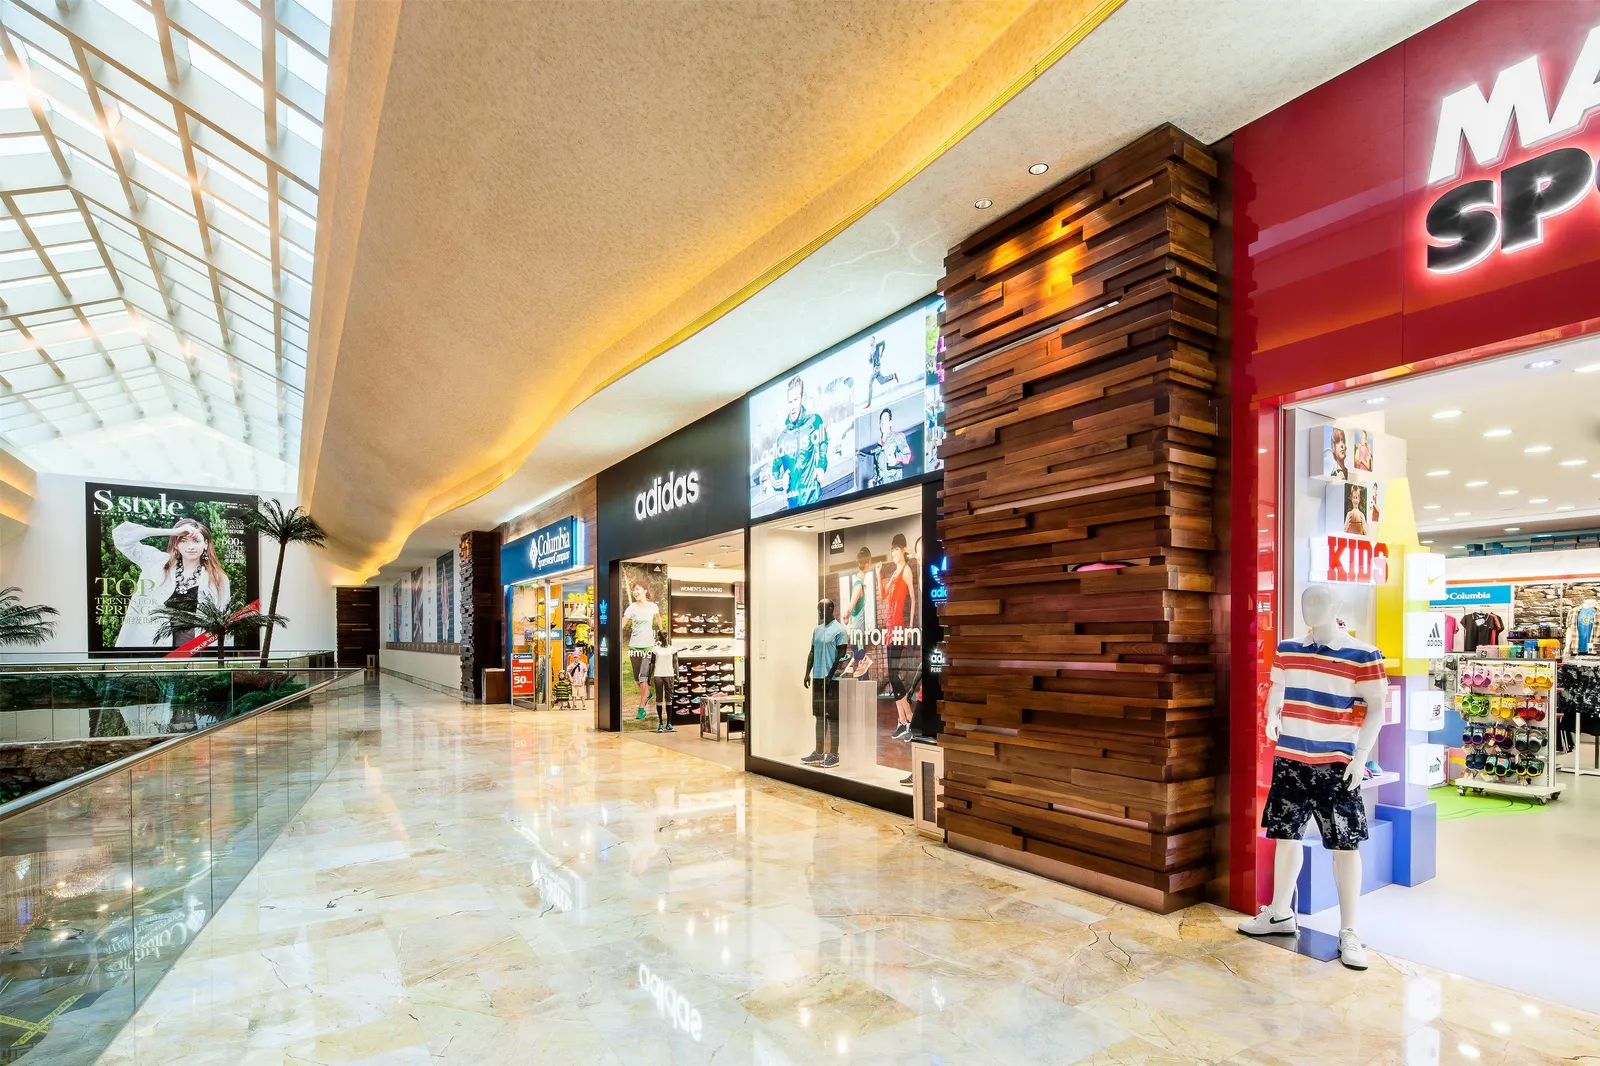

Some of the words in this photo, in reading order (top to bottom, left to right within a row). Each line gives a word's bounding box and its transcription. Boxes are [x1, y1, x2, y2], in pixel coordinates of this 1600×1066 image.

[1426, 147, 1600, 274] SP
[118, 493, 184, 516] style
[635, 471, 699, 521] adidas
[538, 527, 570, 557] Columbia
[1327, 536, 1389, 585] KIDS
[95, 577, 156, 597] TOP
[1449, 592, 1490, 600] Columbia
[95, 597, 136, 605] TRENDS
[95, 605, 151, 615] SPRING
[892, 626, 922, 645] #m
[628, 648, 652, 659] #myg
